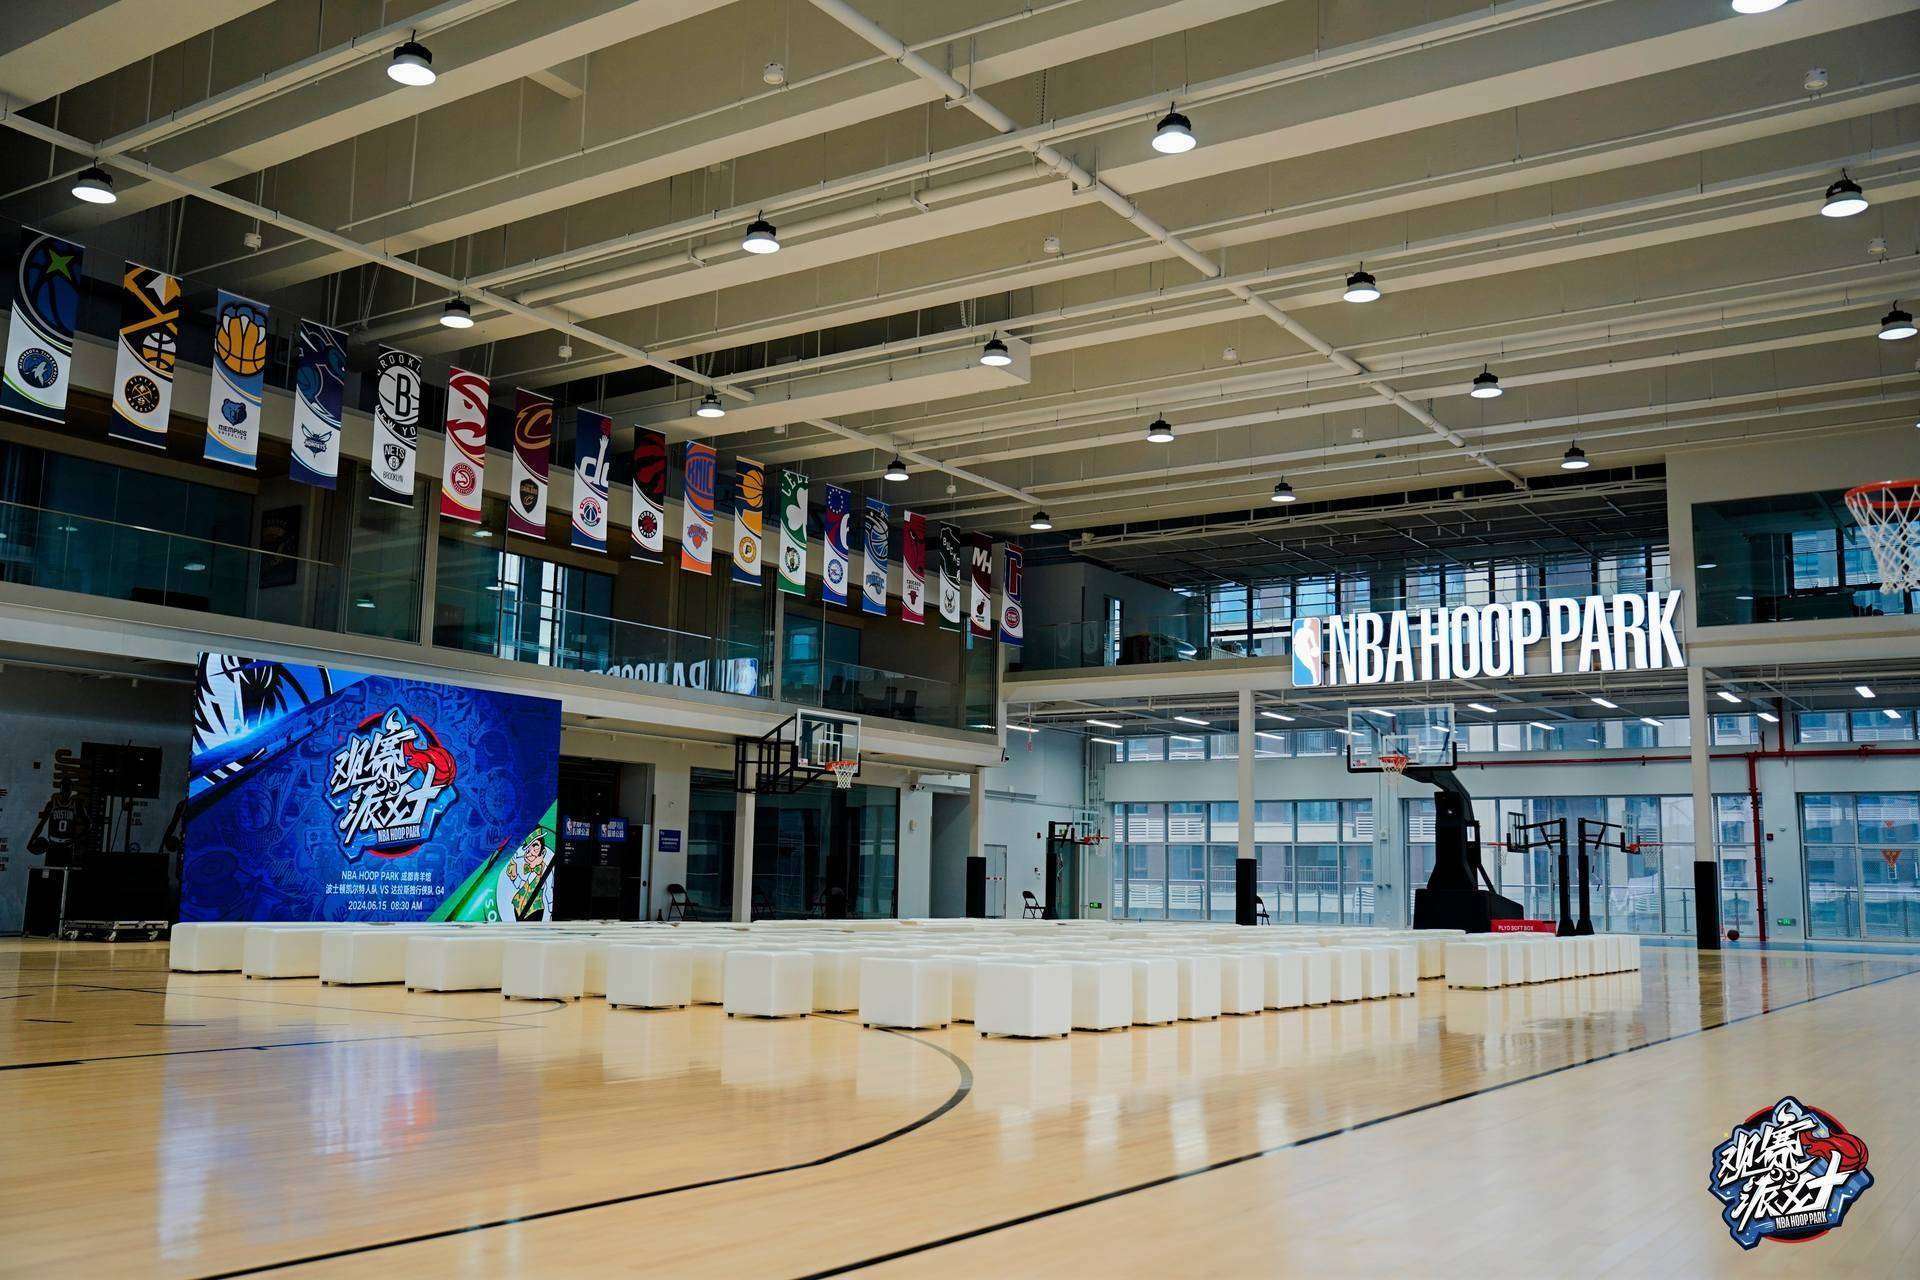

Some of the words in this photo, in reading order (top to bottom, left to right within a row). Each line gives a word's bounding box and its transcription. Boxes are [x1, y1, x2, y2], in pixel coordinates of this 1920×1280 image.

[384, 444, 406, 460] NETS
[1329, 610, 1415, 685] NBA
[1420, 599, 1543, 680] HOOP
[1549, 589, 1686, 674] PARK
[341, 870, 357, 881] NBA
[358, 870, 380, 881] HOOP
[380, 871, 400, 881] PARK
[380, 884, 390, 895] VS
[435, 886, 445, 895] G4
[347, 901, 387, 911] 2024.06.15
[390, 901, 410, 911] 08:30
[410, 901, 423, 911] AM
